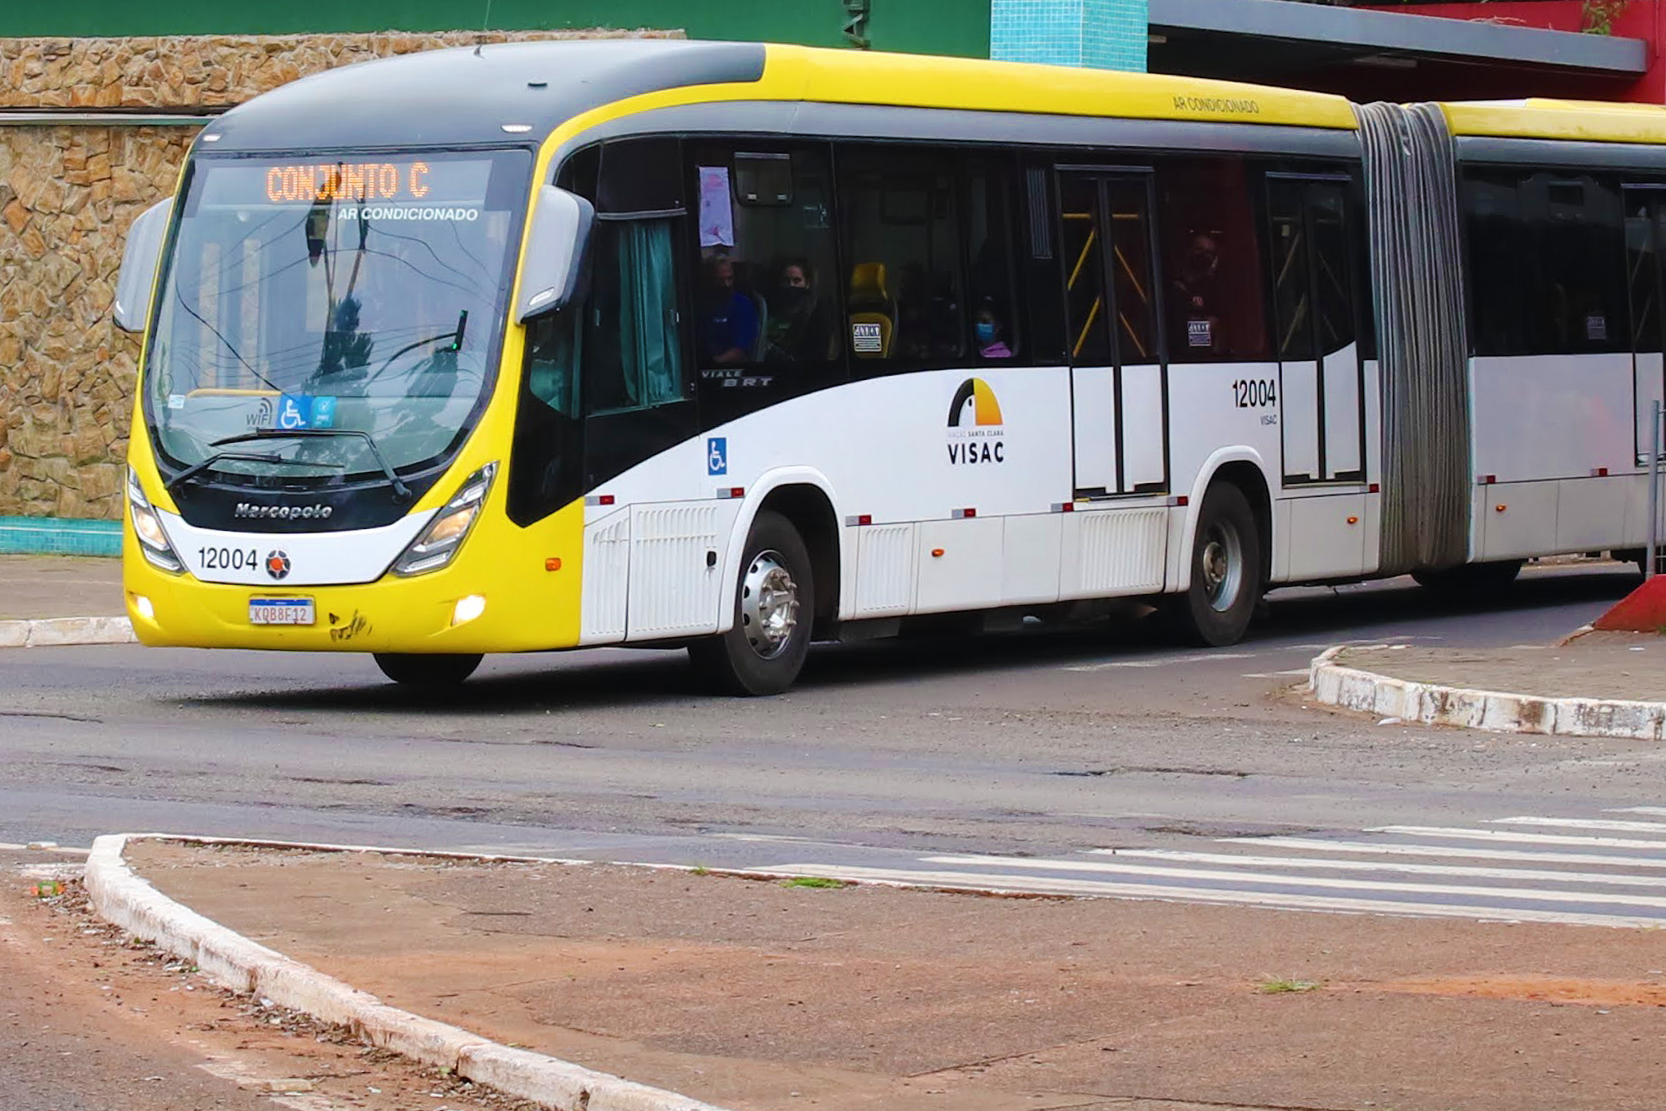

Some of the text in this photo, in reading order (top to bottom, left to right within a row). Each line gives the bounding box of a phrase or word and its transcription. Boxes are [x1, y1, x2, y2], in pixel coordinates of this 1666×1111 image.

[1173, 96, 1260, 114] AR CONDICIONADO
[266, 161, 429, 202] CONJUNTO C
[337, 207, 479, 222] AR CONDICIONADO
[701, 370, 741, 378] VIALE
[724, 378, 772, 387] BRT
[1232, 379, 1276, 408] 12004
[948, 441, 1004, 464] VISAC
[234, 503, 333, 520] Marcopolo
[199, 547, 258, 571] 12004
